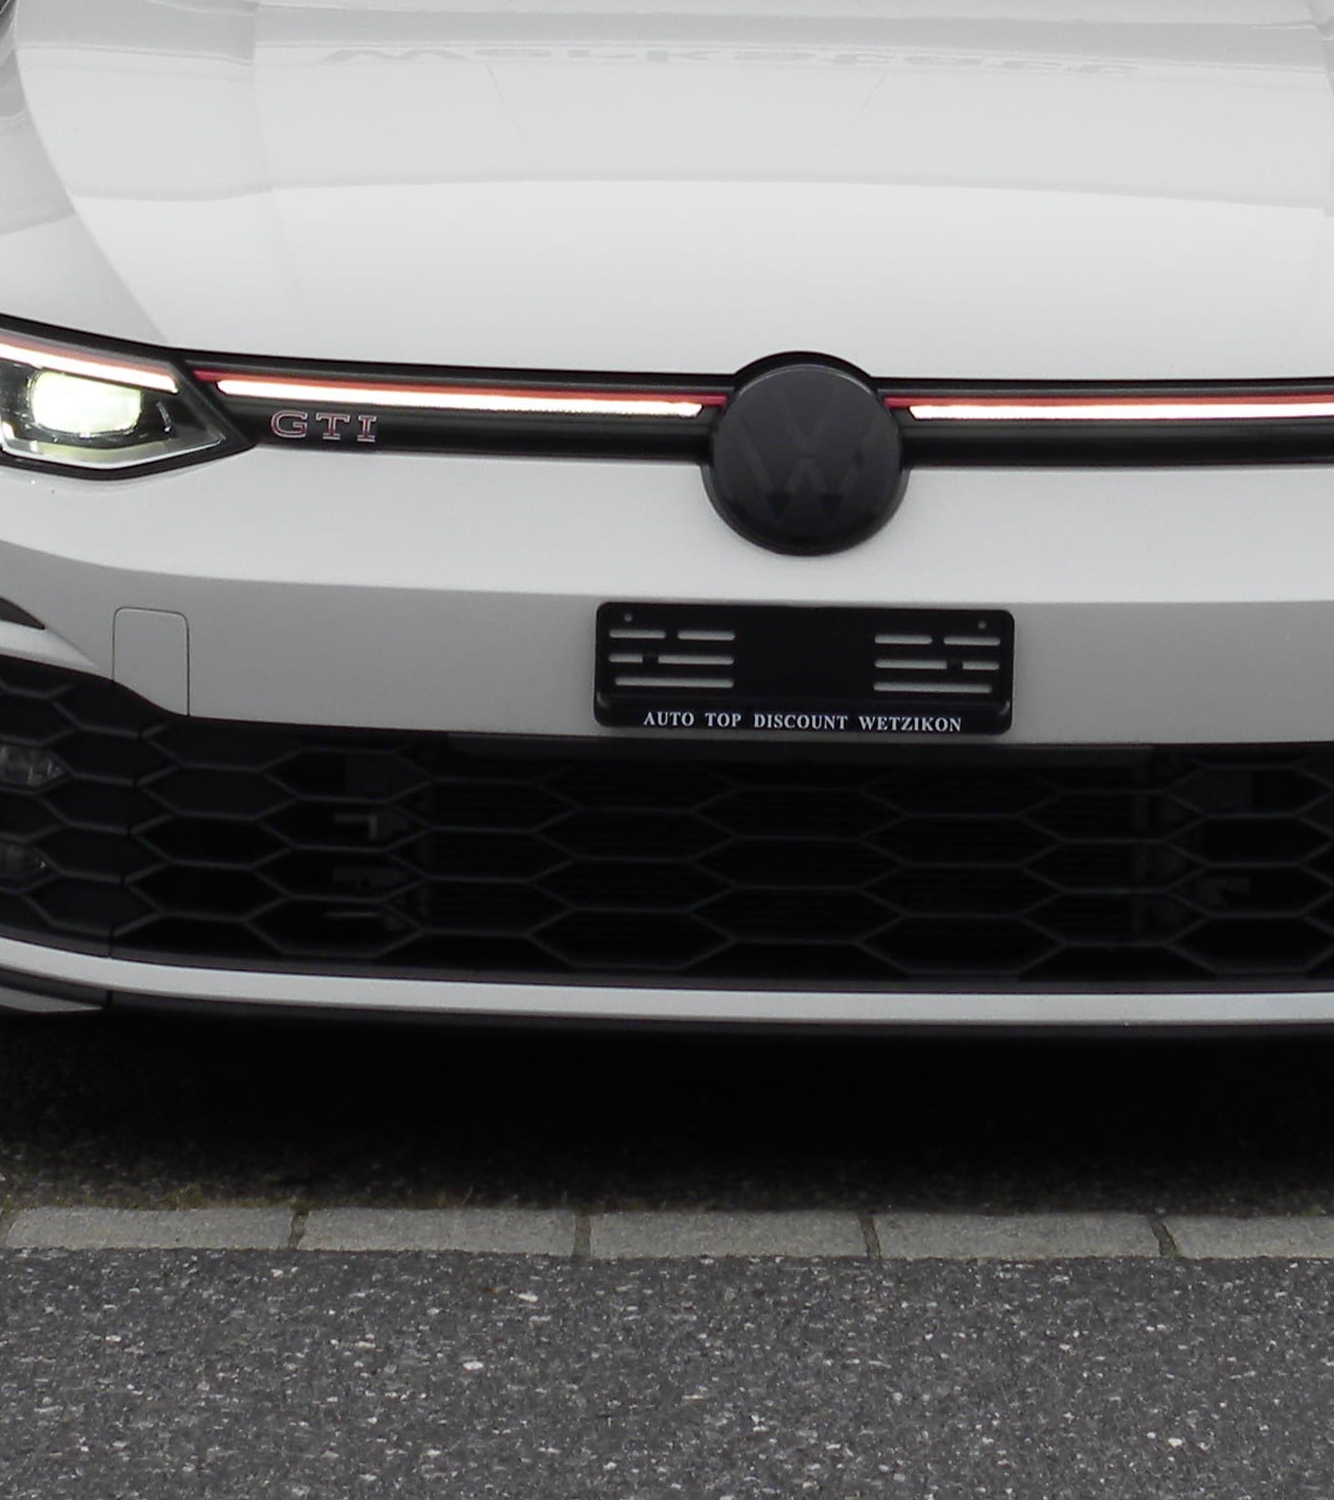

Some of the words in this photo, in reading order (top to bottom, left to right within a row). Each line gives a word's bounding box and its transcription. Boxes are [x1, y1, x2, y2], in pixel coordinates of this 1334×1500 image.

[270, 410, 377, 442] GTI
[643, 711, 695, 728] AUTO
[705, 712, 742, 728] TOP
[753, 713, 848, 731] DISCOUNT
[858, 714, 963, 733] WETZIKON
